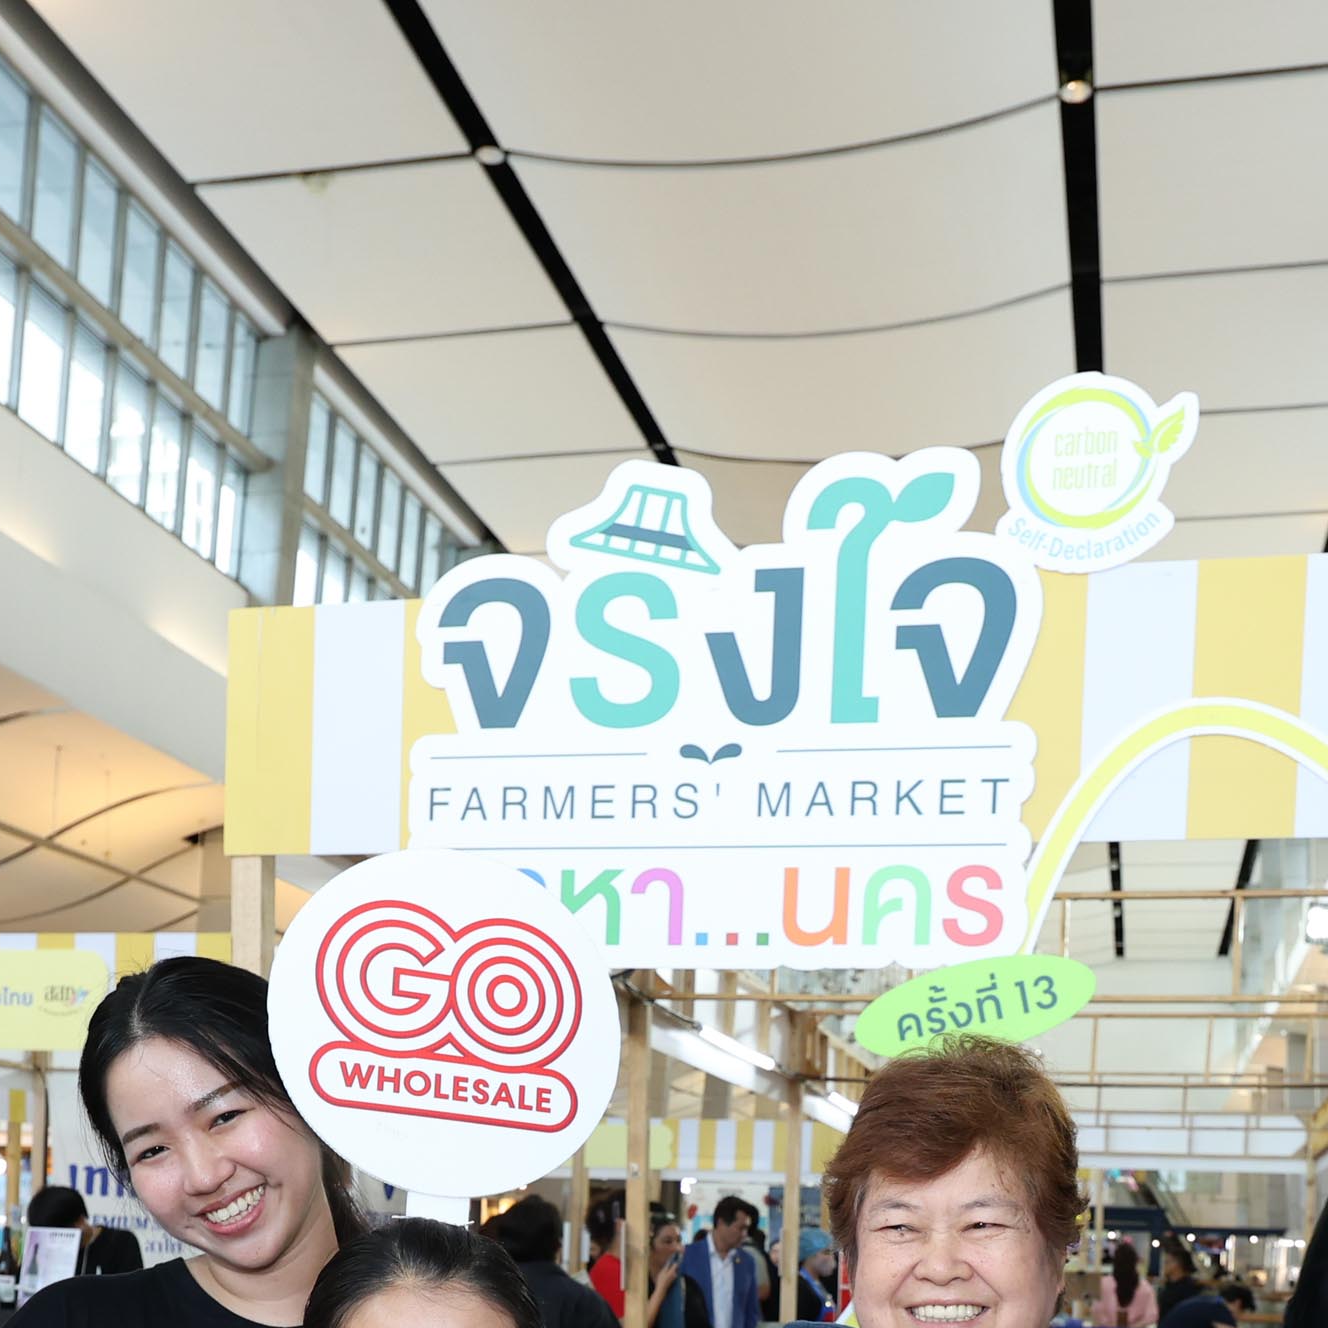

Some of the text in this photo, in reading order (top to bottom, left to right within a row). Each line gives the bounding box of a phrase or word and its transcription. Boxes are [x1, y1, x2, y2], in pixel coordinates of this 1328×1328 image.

[1055, 426, 1118, 457] carbon
[1052, 458, 1118, 490] neutral
[1008, 511, 1161, 561] Self-Declaration
[428, 778, 1010, 822] FARMERS' MARKET
[315, 899, 583, 1070] GO
[896, 970, 1060, 1044] ครั้งที่ 13
[339, 1060, 553, 1115] WHOLESALE
